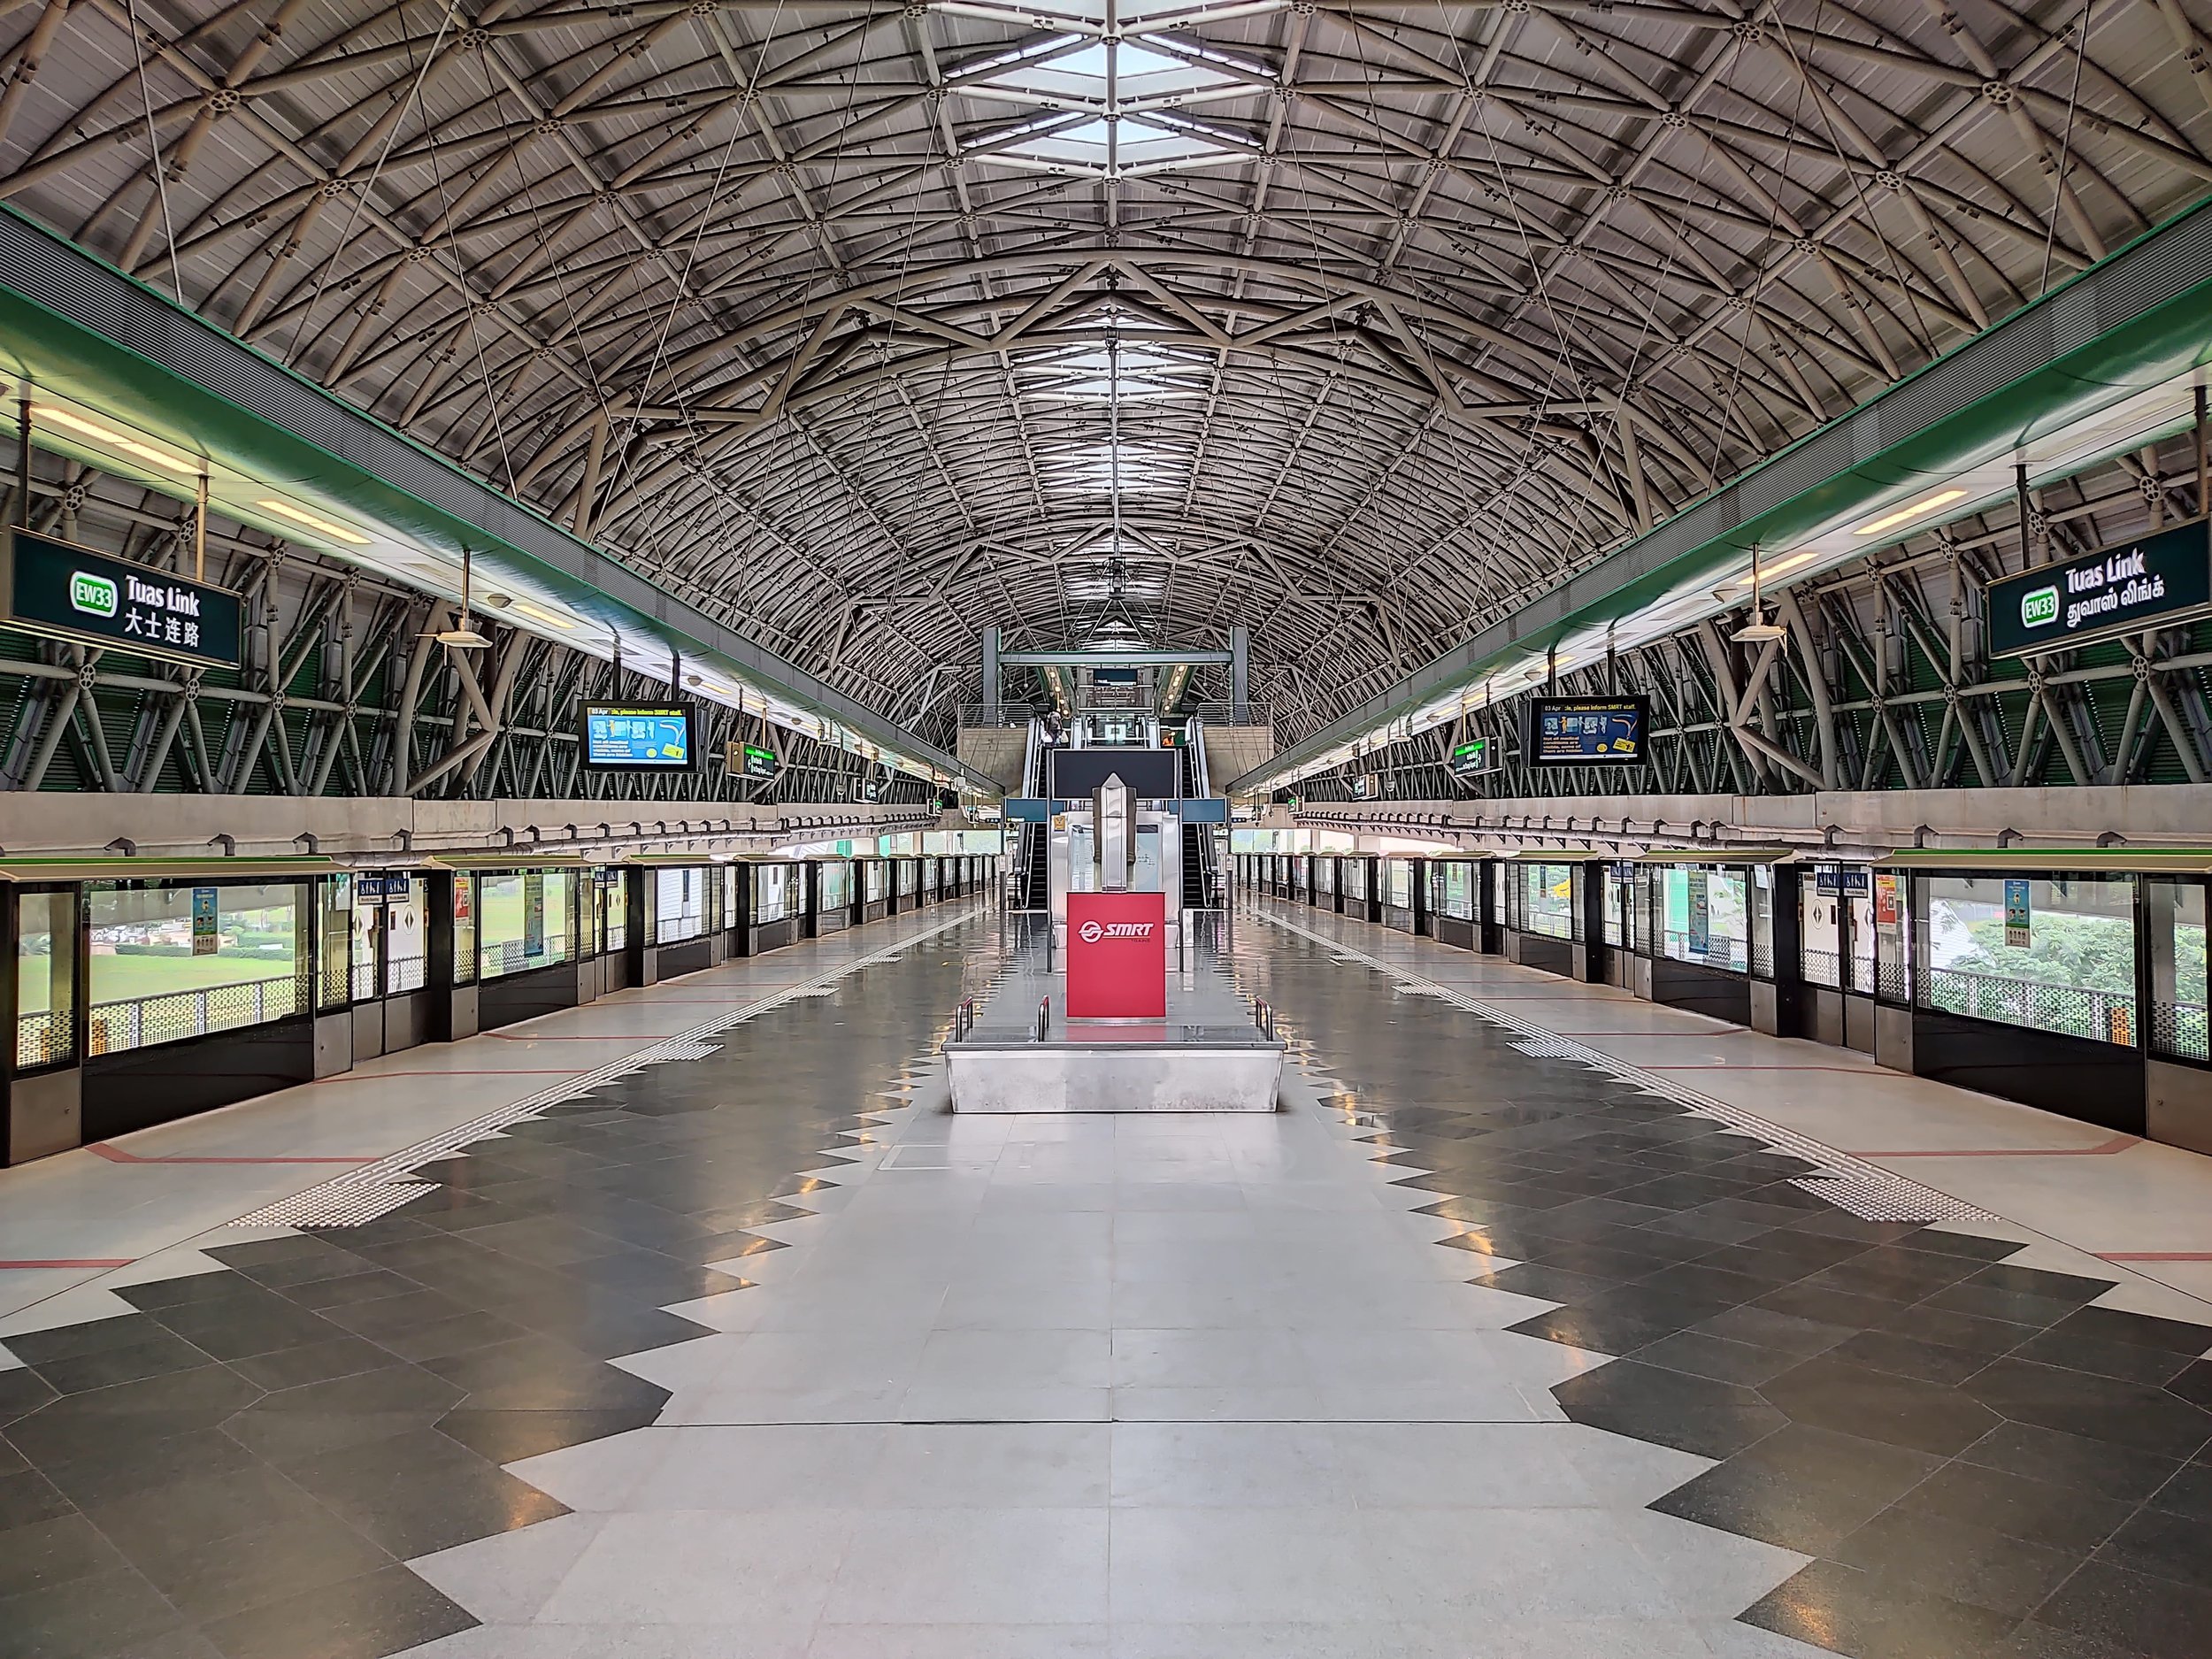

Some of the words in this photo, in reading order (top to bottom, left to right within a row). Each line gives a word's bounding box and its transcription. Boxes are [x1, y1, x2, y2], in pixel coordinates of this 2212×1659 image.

[2065, 565, 2103, 594] Tuas
[2106, 548, 2147, 583] Link
[75, 580, 112, 608] EW33
[125, 574, 165, 608] Tuas
[167, 587, 200, 617] Link
[2024, 596, 2055, 619] EW33
[2067, 587, 2117, 628] துவாஸ்
[2121, 573, 2164, 606] லிங்க்
[124, 608, 200, 648] 大士连路
[1103, 923, 1155, 936] SMRT
